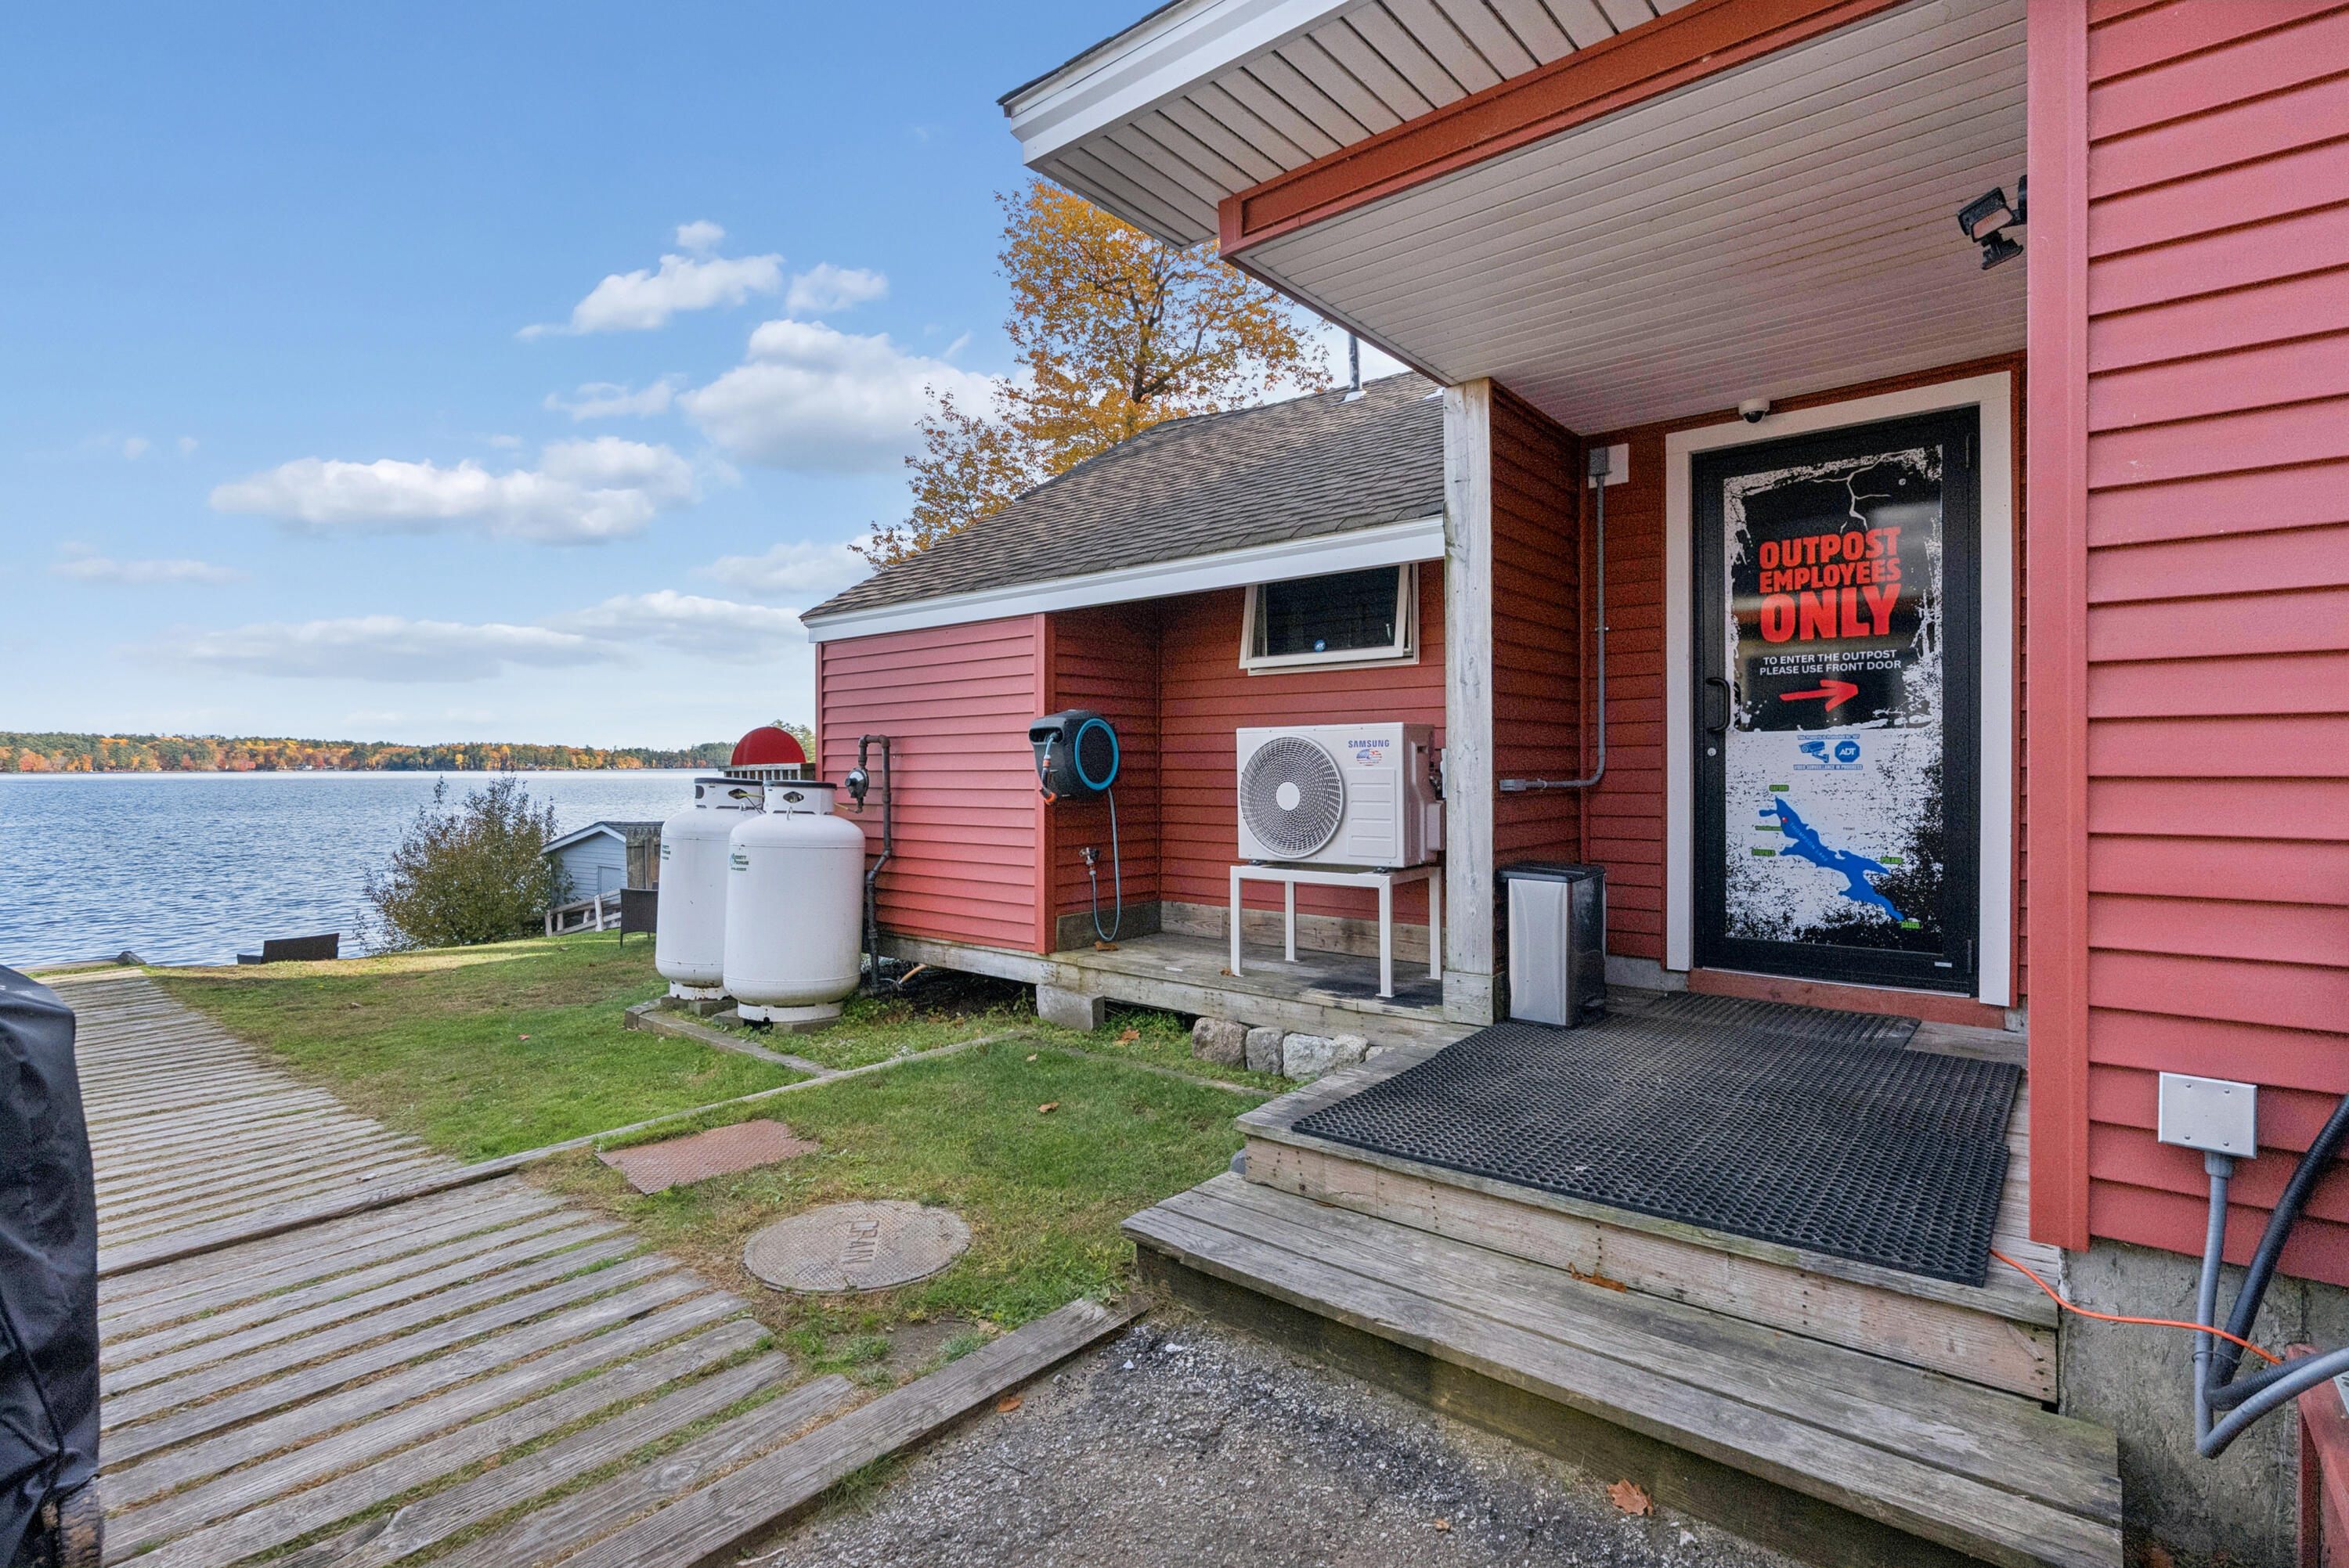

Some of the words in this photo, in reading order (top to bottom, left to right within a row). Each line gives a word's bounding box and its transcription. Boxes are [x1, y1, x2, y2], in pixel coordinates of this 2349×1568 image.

[1759, 526, 1901, 569] OUTPOST
[1759, 557, 1902, 593] EMPLOYEES
[1760, 582, 1902, 643] ONLY
[1759, 665, 1799, 676] PLEASE
[1802, 664, 1824, 674] USE
[1825, 661, 1864, 672] FRONT
[1867, 660, 1901, 670] DOOR
[1763, 657, 1777, 665] TO
[1780, 654, 1815, 665] ENTER
[1817, 653, 1839, 662] THE
[1842, 650, 1897, 661] OUTPOST
[1348, 739, 1390, 748] SAMSUNG
